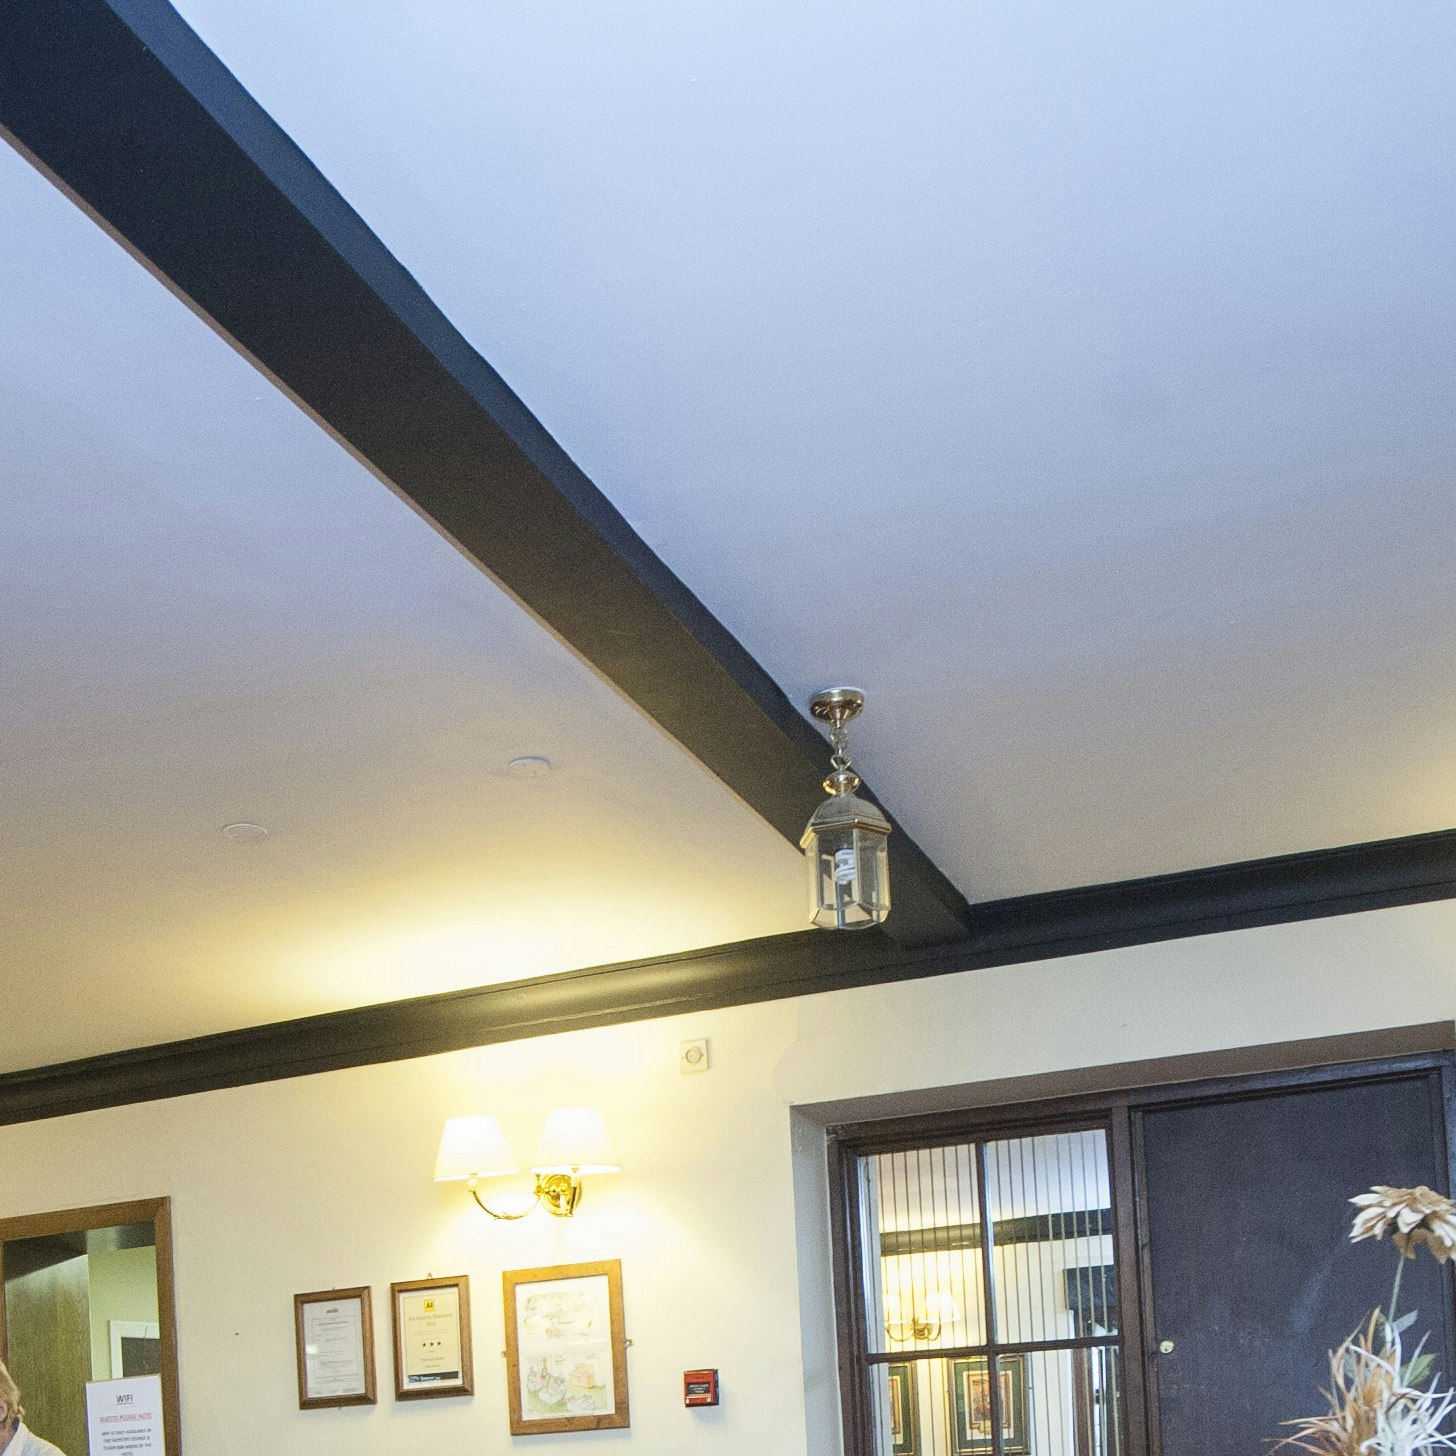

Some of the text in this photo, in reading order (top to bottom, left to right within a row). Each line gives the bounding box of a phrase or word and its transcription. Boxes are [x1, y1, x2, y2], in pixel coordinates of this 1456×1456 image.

[116, 1394, 133, 1404] WIFI
[119, 1414, 137, 1422] PLEASE
[138, 1412, 152, 1420] NOTE
